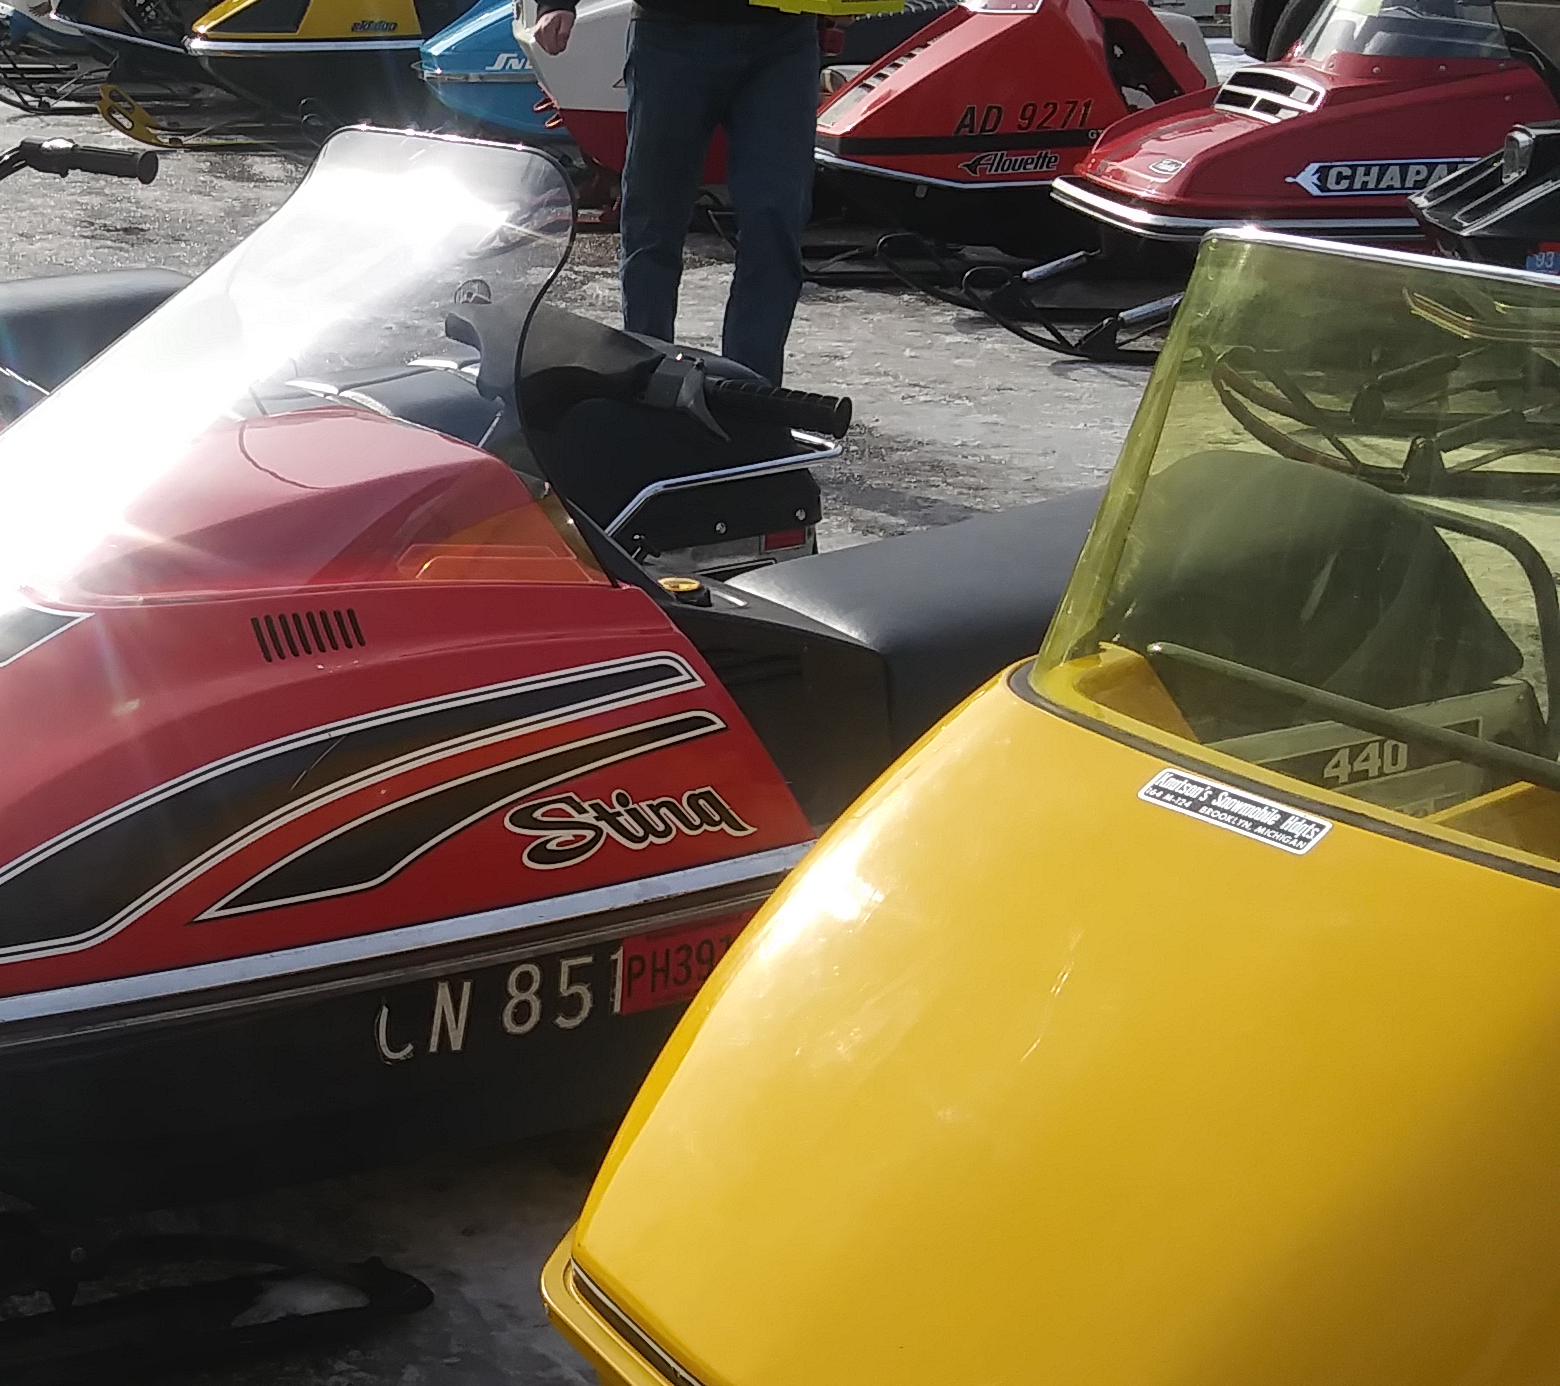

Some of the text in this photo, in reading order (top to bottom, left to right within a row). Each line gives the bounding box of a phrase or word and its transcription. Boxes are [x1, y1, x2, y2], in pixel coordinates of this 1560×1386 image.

[953, 97, 1094, 136] AD 9271
[1323, 739, 1408, 784] 440
[1212, 791, 1281, 826] Snowmobile
[503, 786, 758, 871] Sting
[1254, 825, 1307, 849] MICHIGAN
